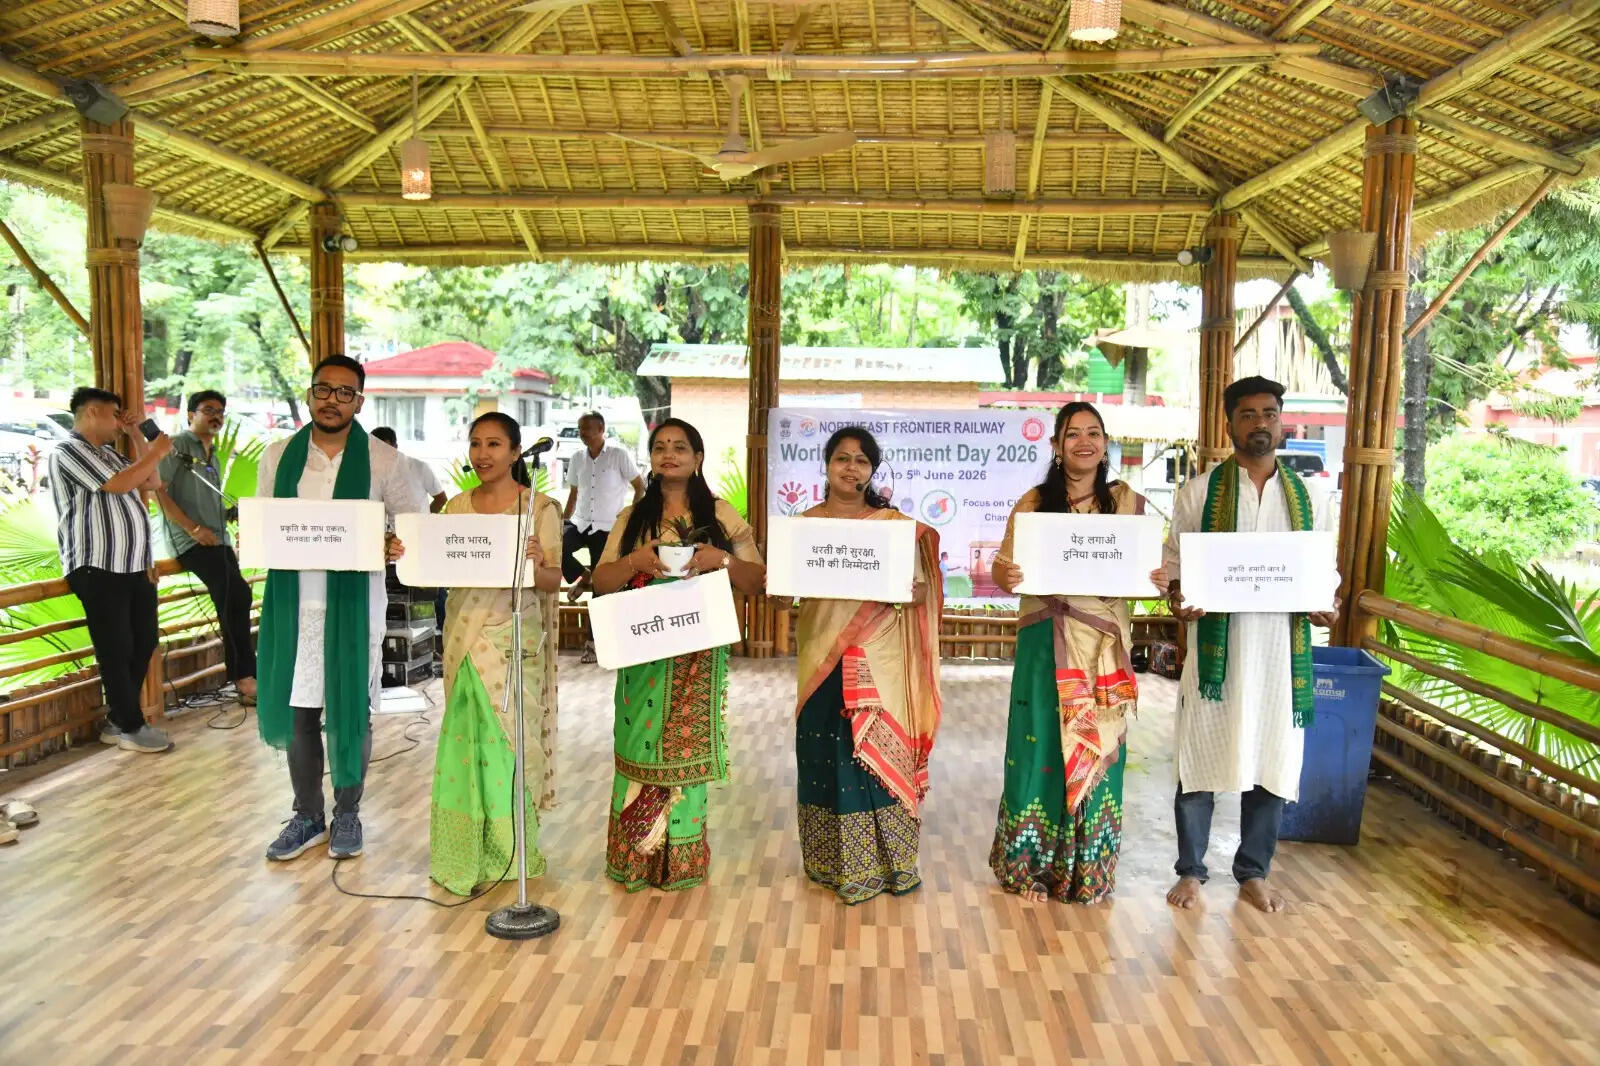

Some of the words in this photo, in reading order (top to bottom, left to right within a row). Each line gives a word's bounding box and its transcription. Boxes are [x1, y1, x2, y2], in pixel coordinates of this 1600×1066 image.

[892, 421, 951, 434] FRONTIER
[954, 421, 1006, 434] RAILWAY
[780, 443, 826, 462] Worl
[884, 444, 952, 462] onment
[957, 443, 991, 467] Day
[996, 444, 1038, 463] 2026
[872, 471, 887, 482] ay
[906, 469, 921, 480] 5th
[924, 469, 955, 480] June
[958, 469, 987, 480] 2026
[963, 498, 991, 507] Focus
[993, 499, 1005, 507] on
[984, 513, 1008, 521] Chan
[301, 523, 308, 532] के
[312, 535, 322, 543] की
[445, 533, 465, 545] हरित
[467, 536, 492, 546] भारत,
[1087, 533, 1117, 545] लगाओ
[446, 551, 467, 559] स्वस्थ
[470, 551, 491, 559] भारत
[812, 544, 833, 555] धरती
[835, 545, 847, 556] की
[1062, 548, 1089, 562] दुनिया
[1091, 548, 1123, 560] बचाओ!
[806, 557, 825, 568] सभी
[827, 558, 839, 569] की
[630, 614, 665, 636] धरती
[668, 611, 701, 628] माता
[1312, 687, 1346, 697] kamal
